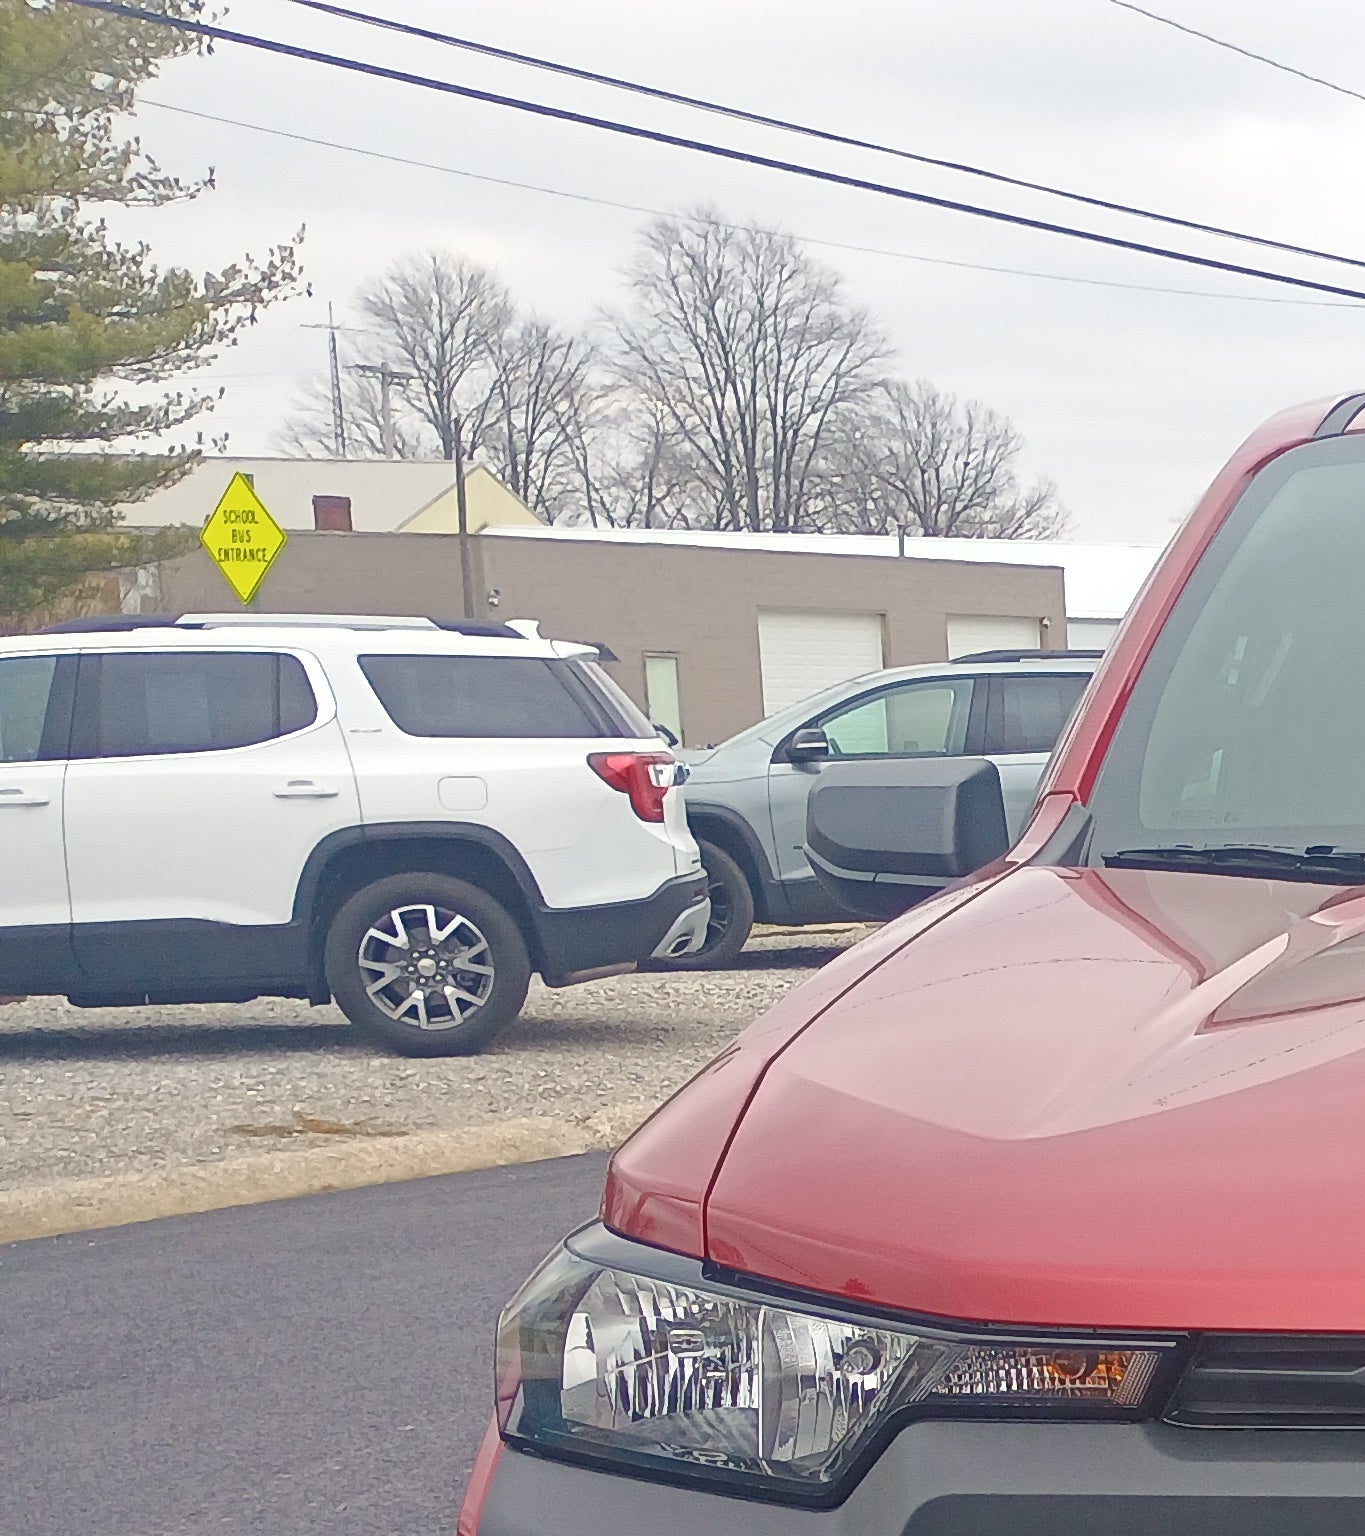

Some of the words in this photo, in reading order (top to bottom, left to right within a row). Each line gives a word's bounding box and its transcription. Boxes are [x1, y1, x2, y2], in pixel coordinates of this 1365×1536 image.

[223, 510, 259, 524] SCHOOL
[231, 529, 251, 543] BUS
[218, 548, 268, 562] ENTRANCE
